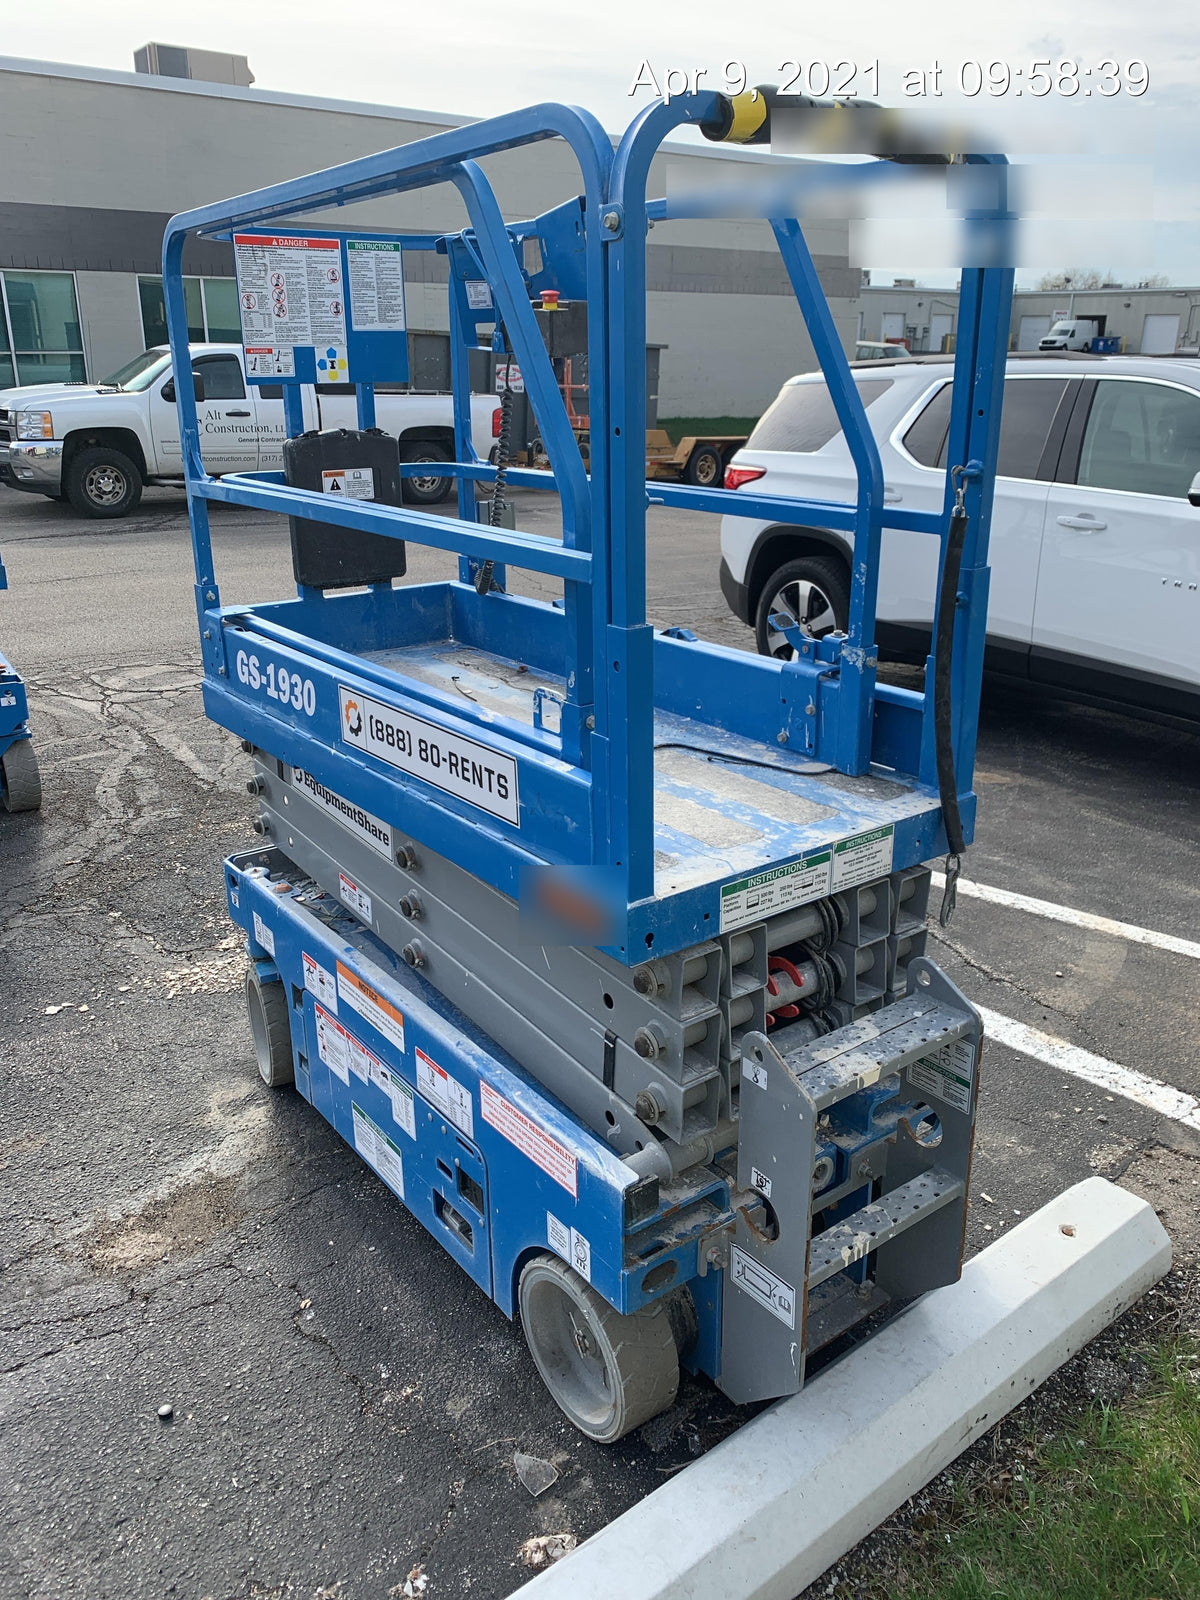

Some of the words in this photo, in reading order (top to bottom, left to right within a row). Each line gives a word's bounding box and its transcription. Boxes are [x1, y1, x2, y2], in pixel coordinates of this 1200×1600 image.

[278, 238, 309, 247] DANGER
[354, 243, 395, 251] INSTRUCTIONS
[205, 410, 221, 420] Alt
[205, 423, 272, 434] Construction,
[275, 425, 287, 433] LL
[236, 650, 316, 717] GS-1930
[369, 714, 412, 757] (888)
[419, 738, 510, 800] 80-RENTS
[304, 770, 390, 847] EquipmentShare
[846, 830, 883, 849] INSTRUCTIONS
[747, 861, 808, 888] INSTRUCTIONS
[359, 981, 378, 1004] NOTICE
[500, 1100, 528, 1126] CUSTOMER
[529, 1123, 575, 1165] RESPONSIBILITY
